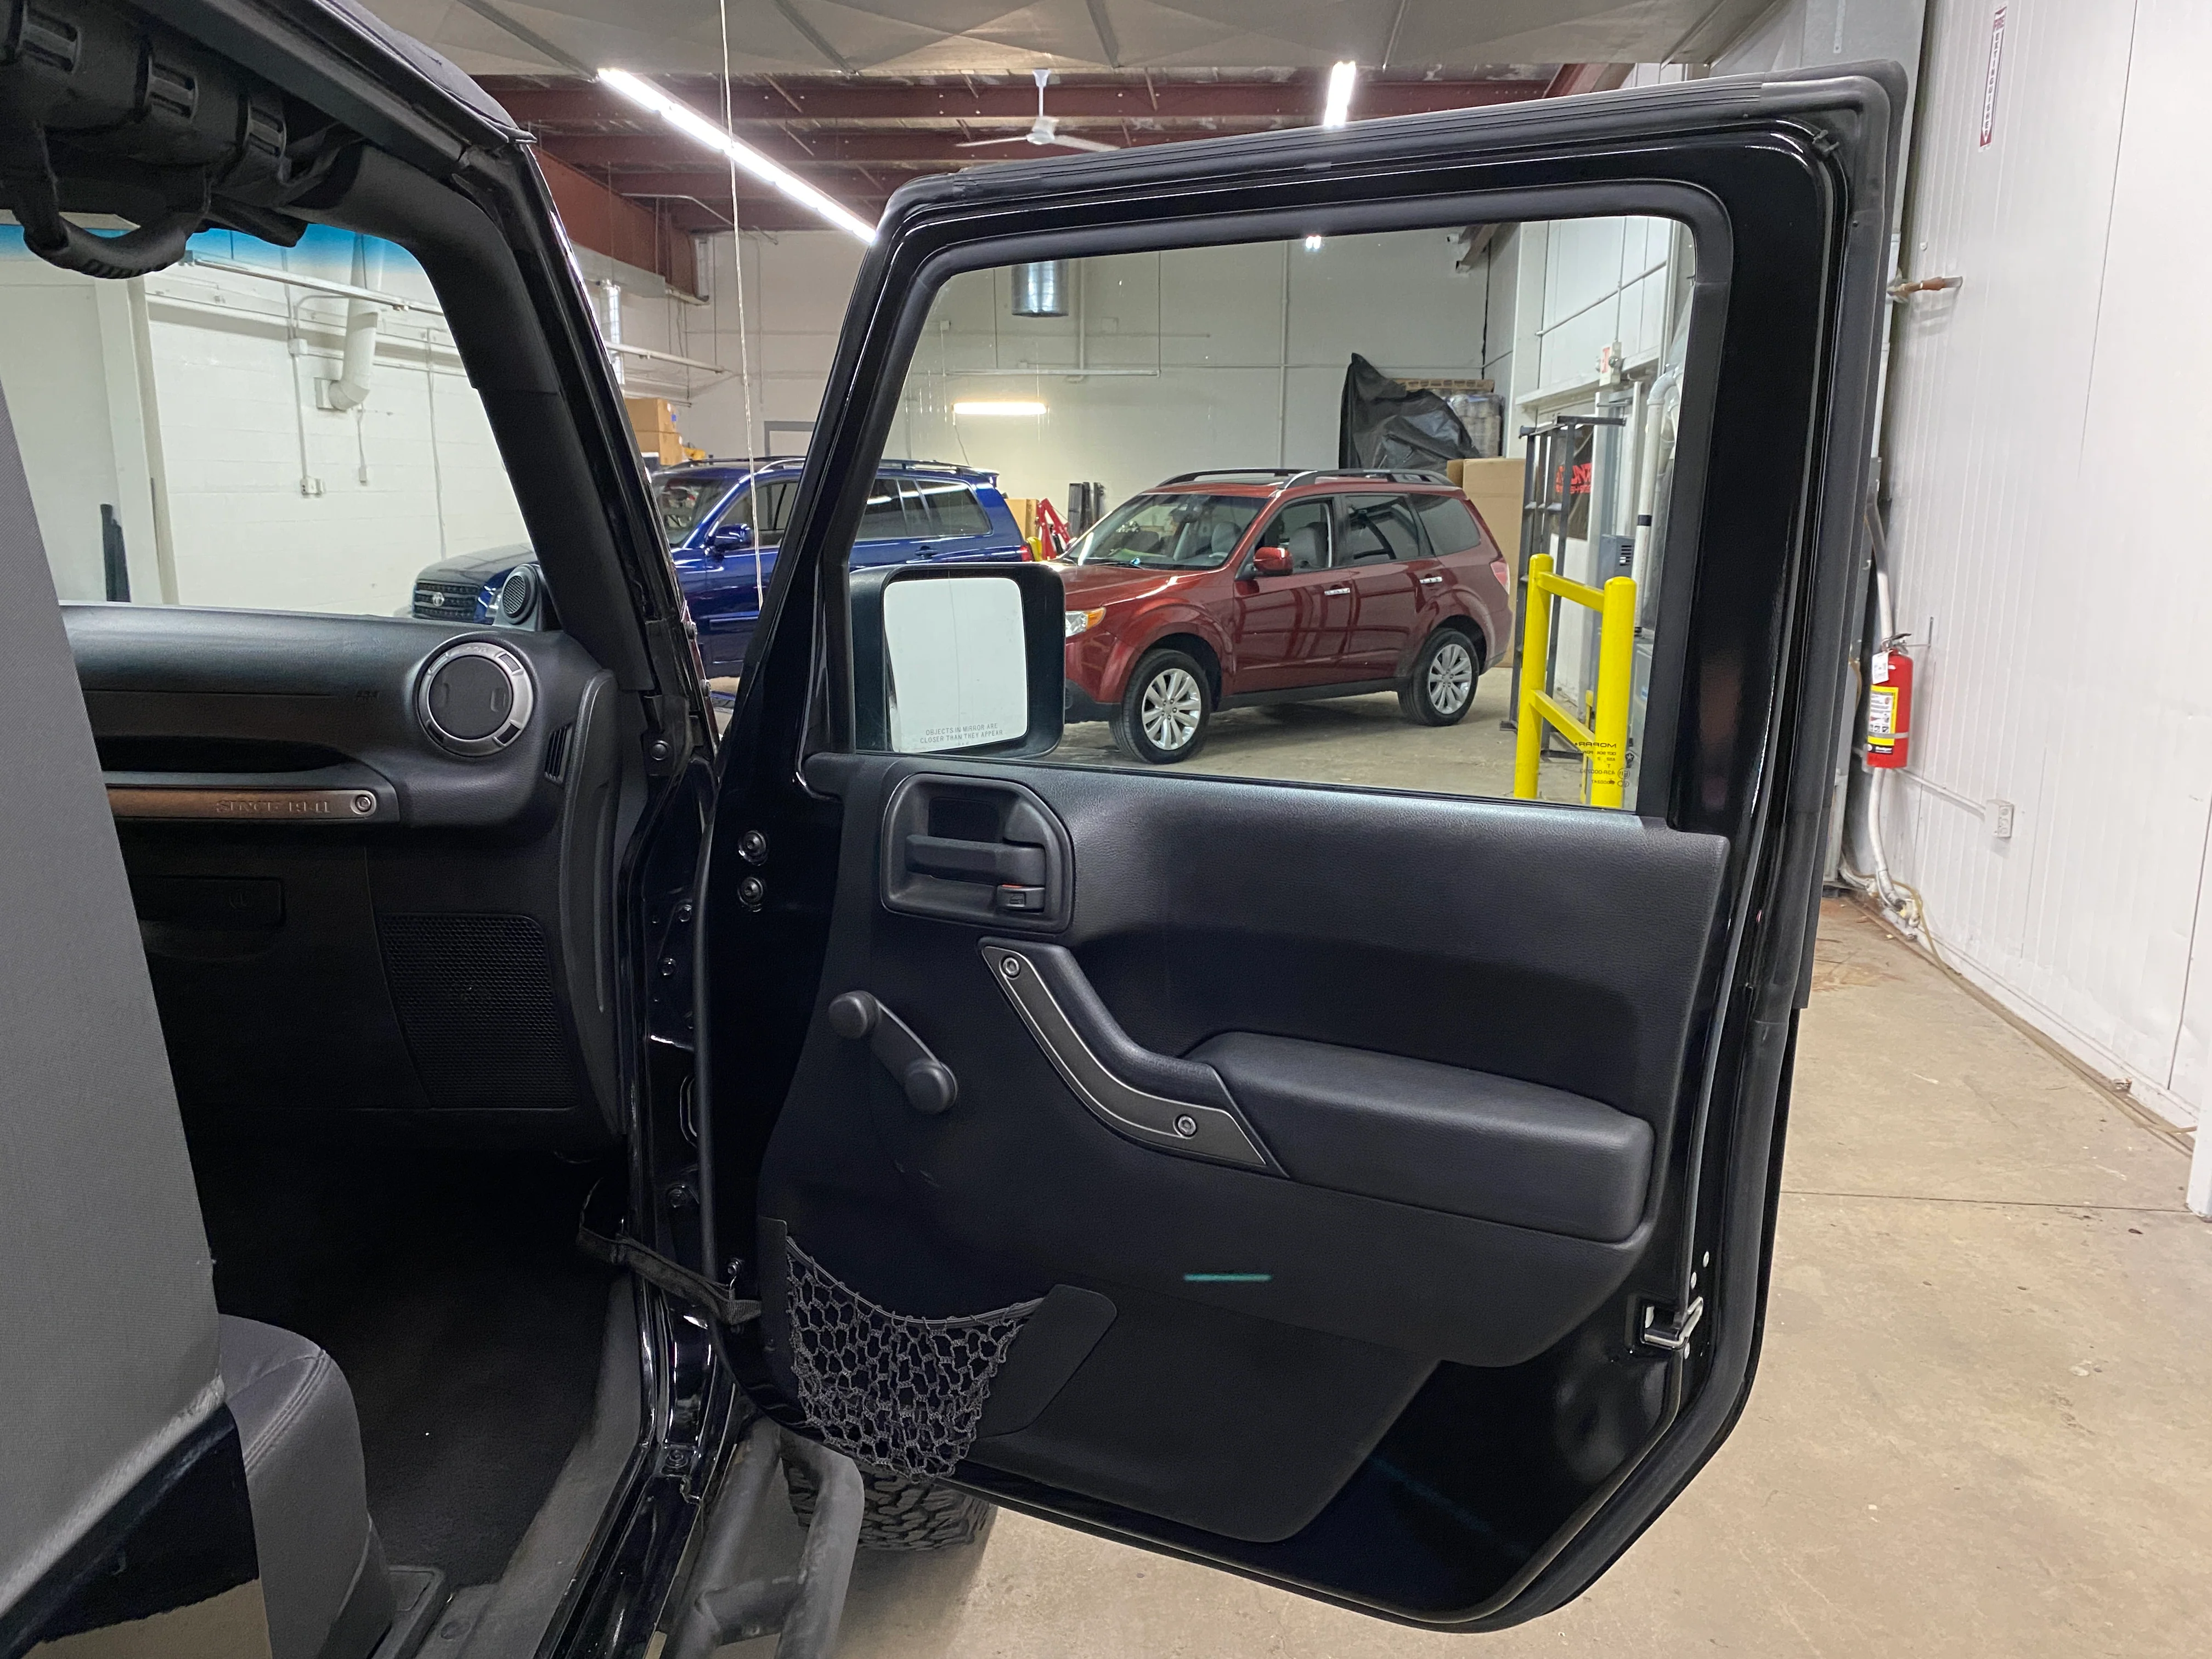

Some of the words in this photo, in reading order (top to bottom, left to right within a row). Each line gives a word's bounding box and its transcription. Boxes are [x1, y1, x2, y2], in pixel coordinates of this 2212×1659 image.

[926, 727, 953, 736] OBJECTS
[963, 724, 985, 732] MIRROR
[920, 735, 944, 744] CLOSER
[981, 730, 1003, 738] APPEAR
[216, 799, 280, 812] SINCE
